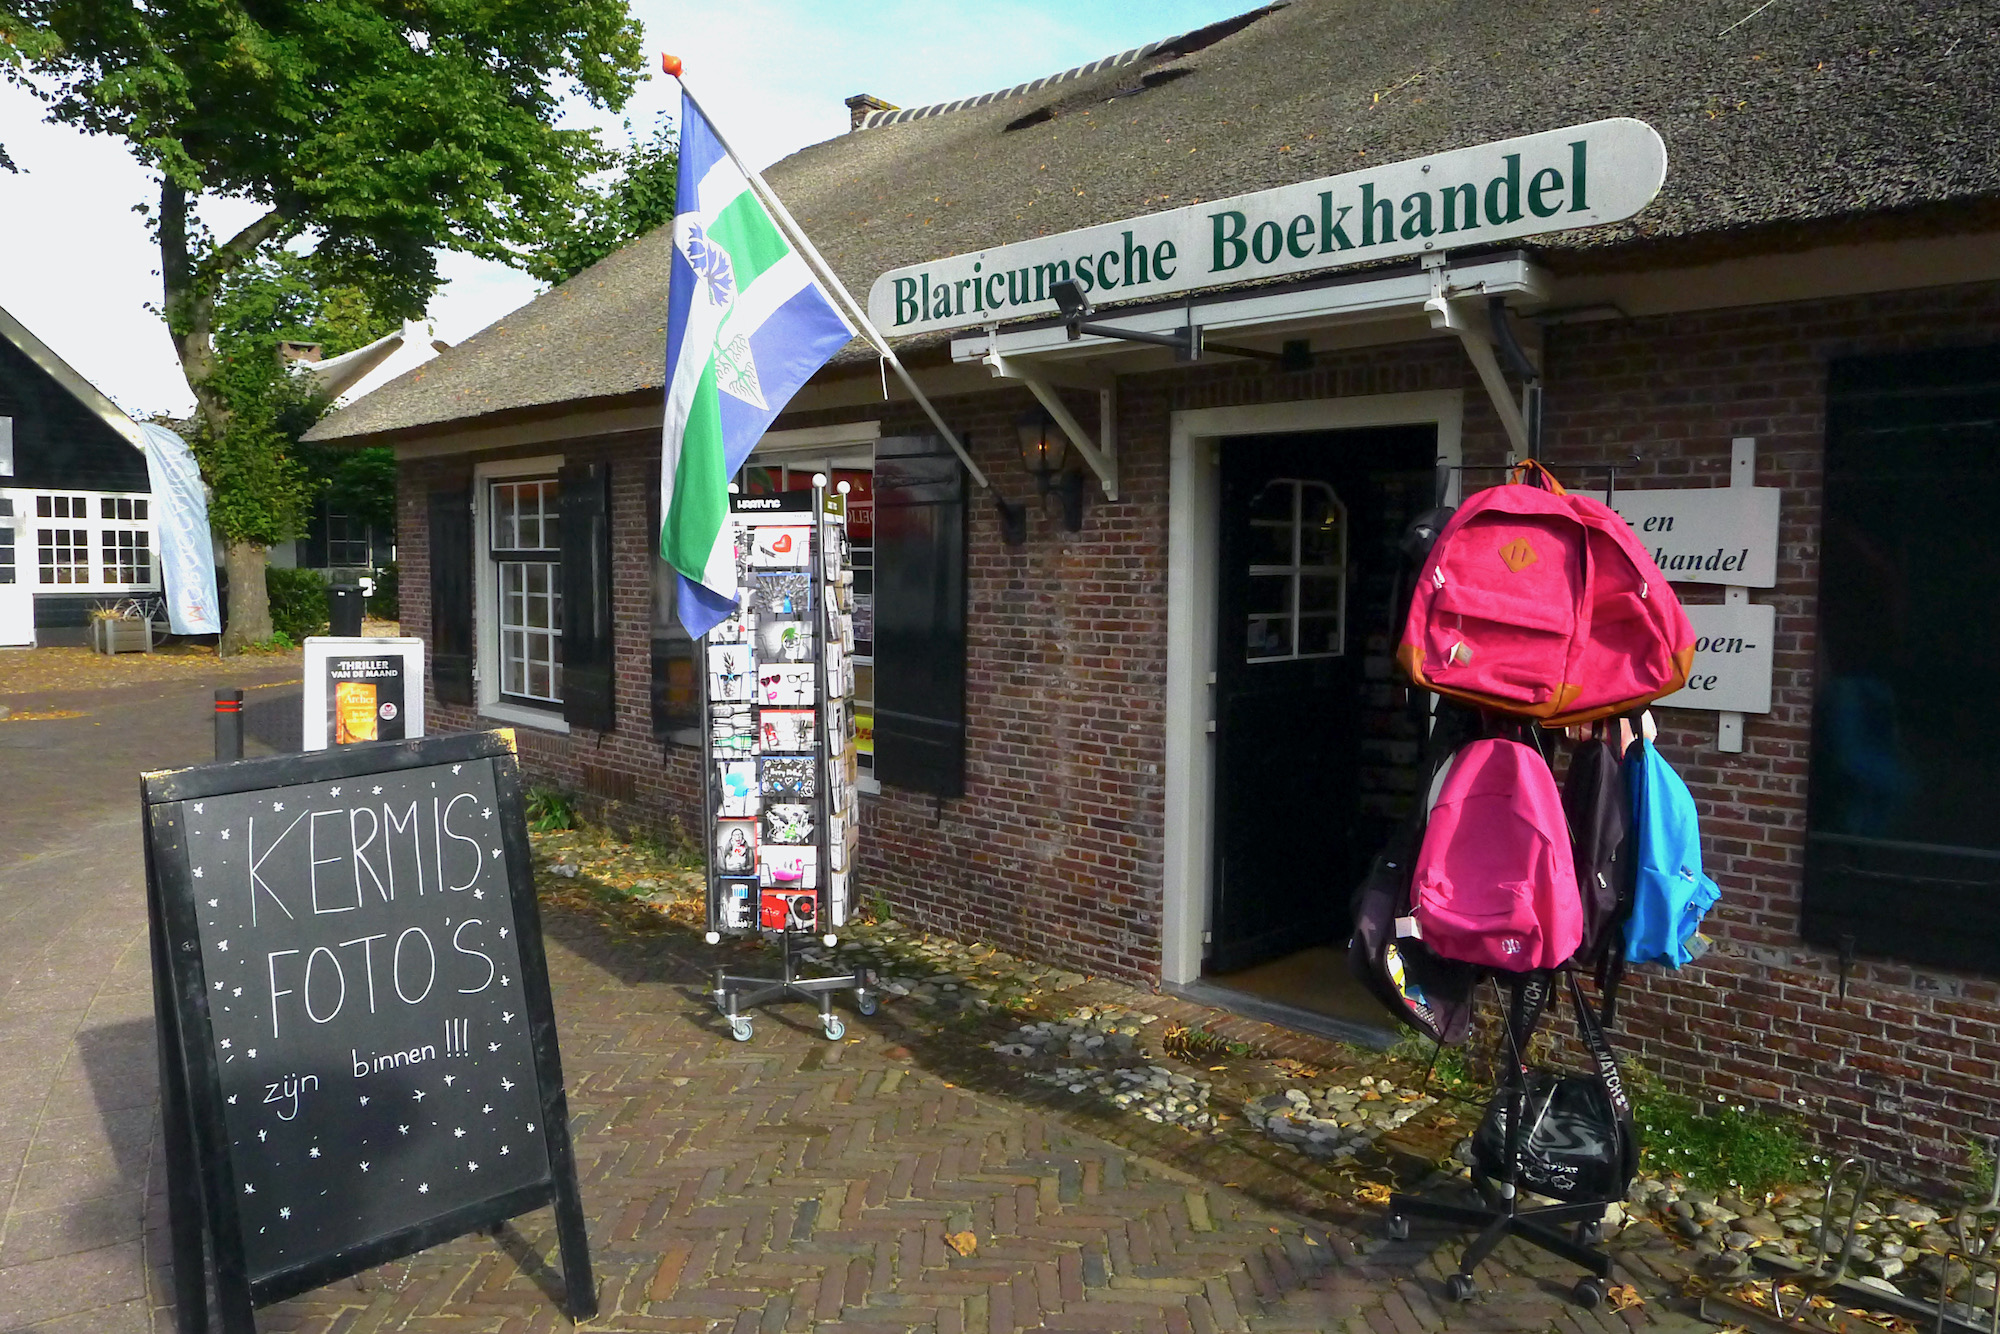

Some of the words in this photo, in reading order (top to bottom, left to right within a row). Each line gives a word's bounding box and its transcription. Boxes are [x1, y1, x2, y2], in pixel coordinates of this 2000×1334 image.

[892, 230, 1177, 327] Blaricumsche
[1207, 140, 1590, 273] Boekhandel
[1643, 515, 1674, 532] en
[1646, 547, 1749, 572] handel
[331, 671, 351, 679] VAN
[365, 670, 398, 678] MAAND
[338, 661, 389, 670] THRILLER
[248, 782, 482, 927] KERMIS
[268, 917, 495, 1039] FOTO'S
[352, 1043, 436, 1078] binnen
